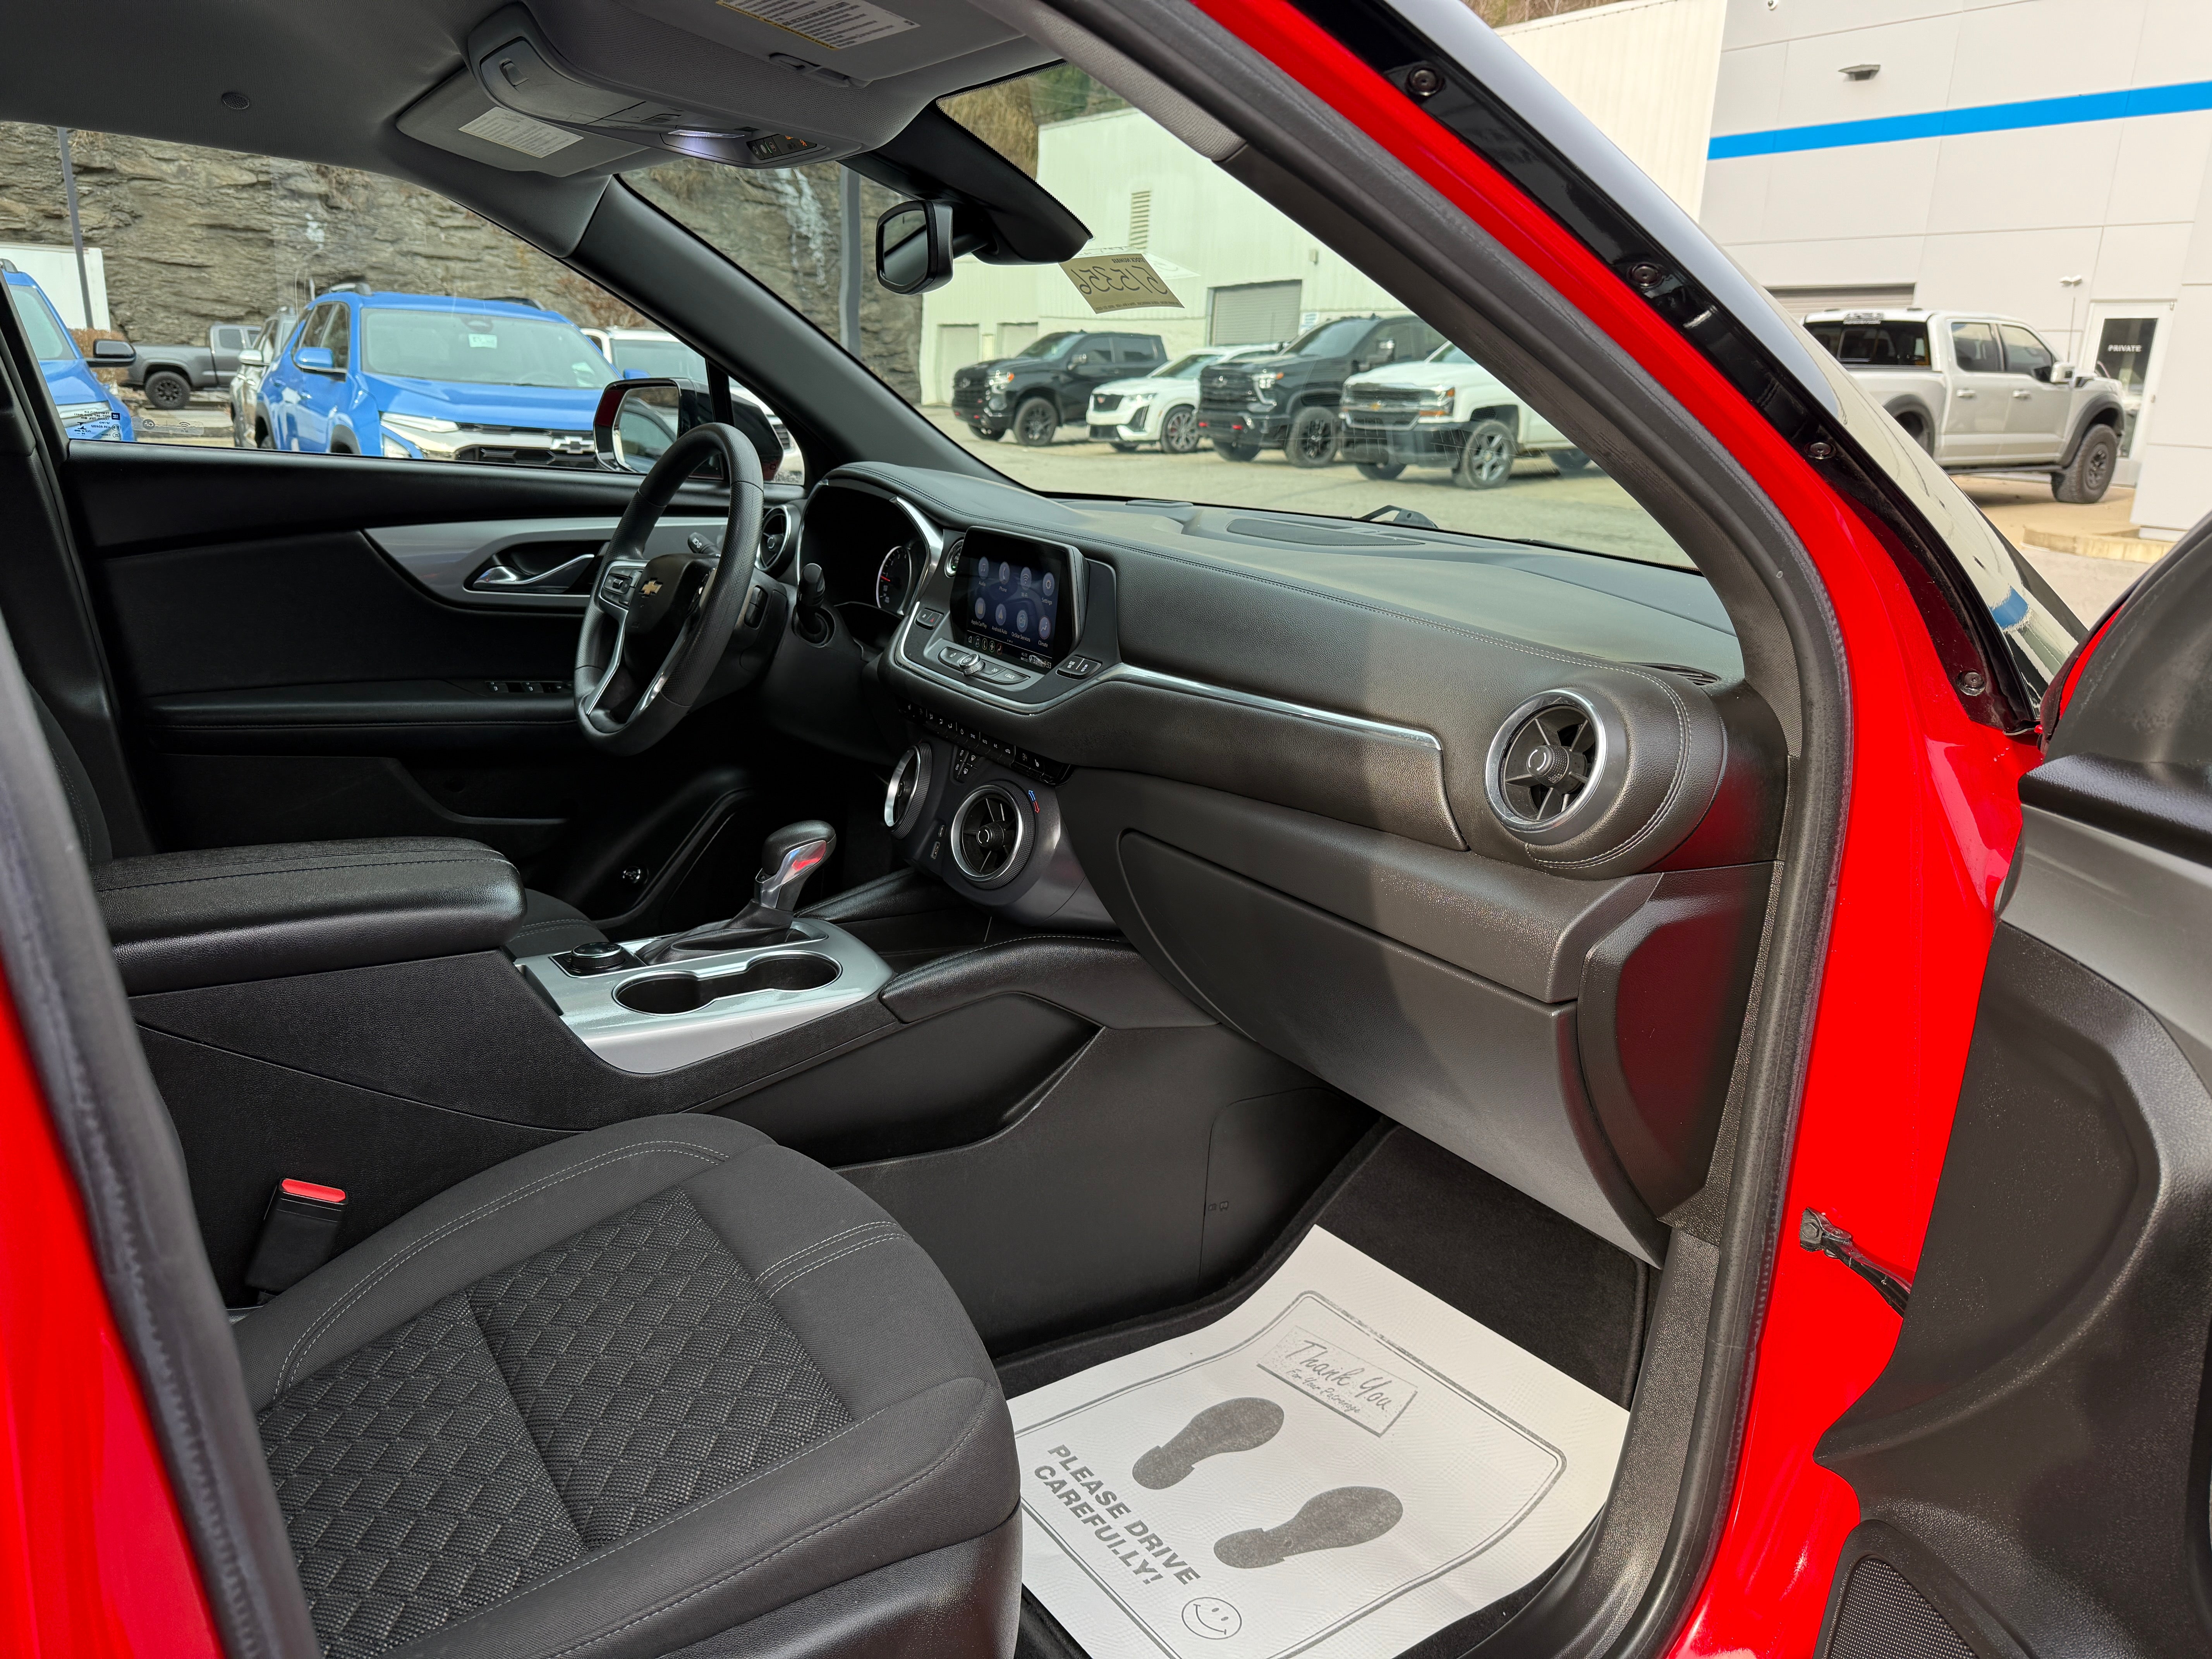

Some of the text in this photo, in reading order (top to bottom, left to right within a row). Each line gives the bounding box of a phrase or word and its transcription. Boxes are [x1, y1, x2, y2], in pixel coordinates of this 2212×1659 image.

[1020, 634, 1030, 642] Services
[1286, 1340, 1393, 1410] Thank You
[1286, 1368, 1302, 1380] For
[1320, 1388, 1360, 1413] Patronage
[1034, 1465, 1164, 1585] CAREFULLY!
[1047, 1444, 1201, 1585] PLEASE DRIVE
